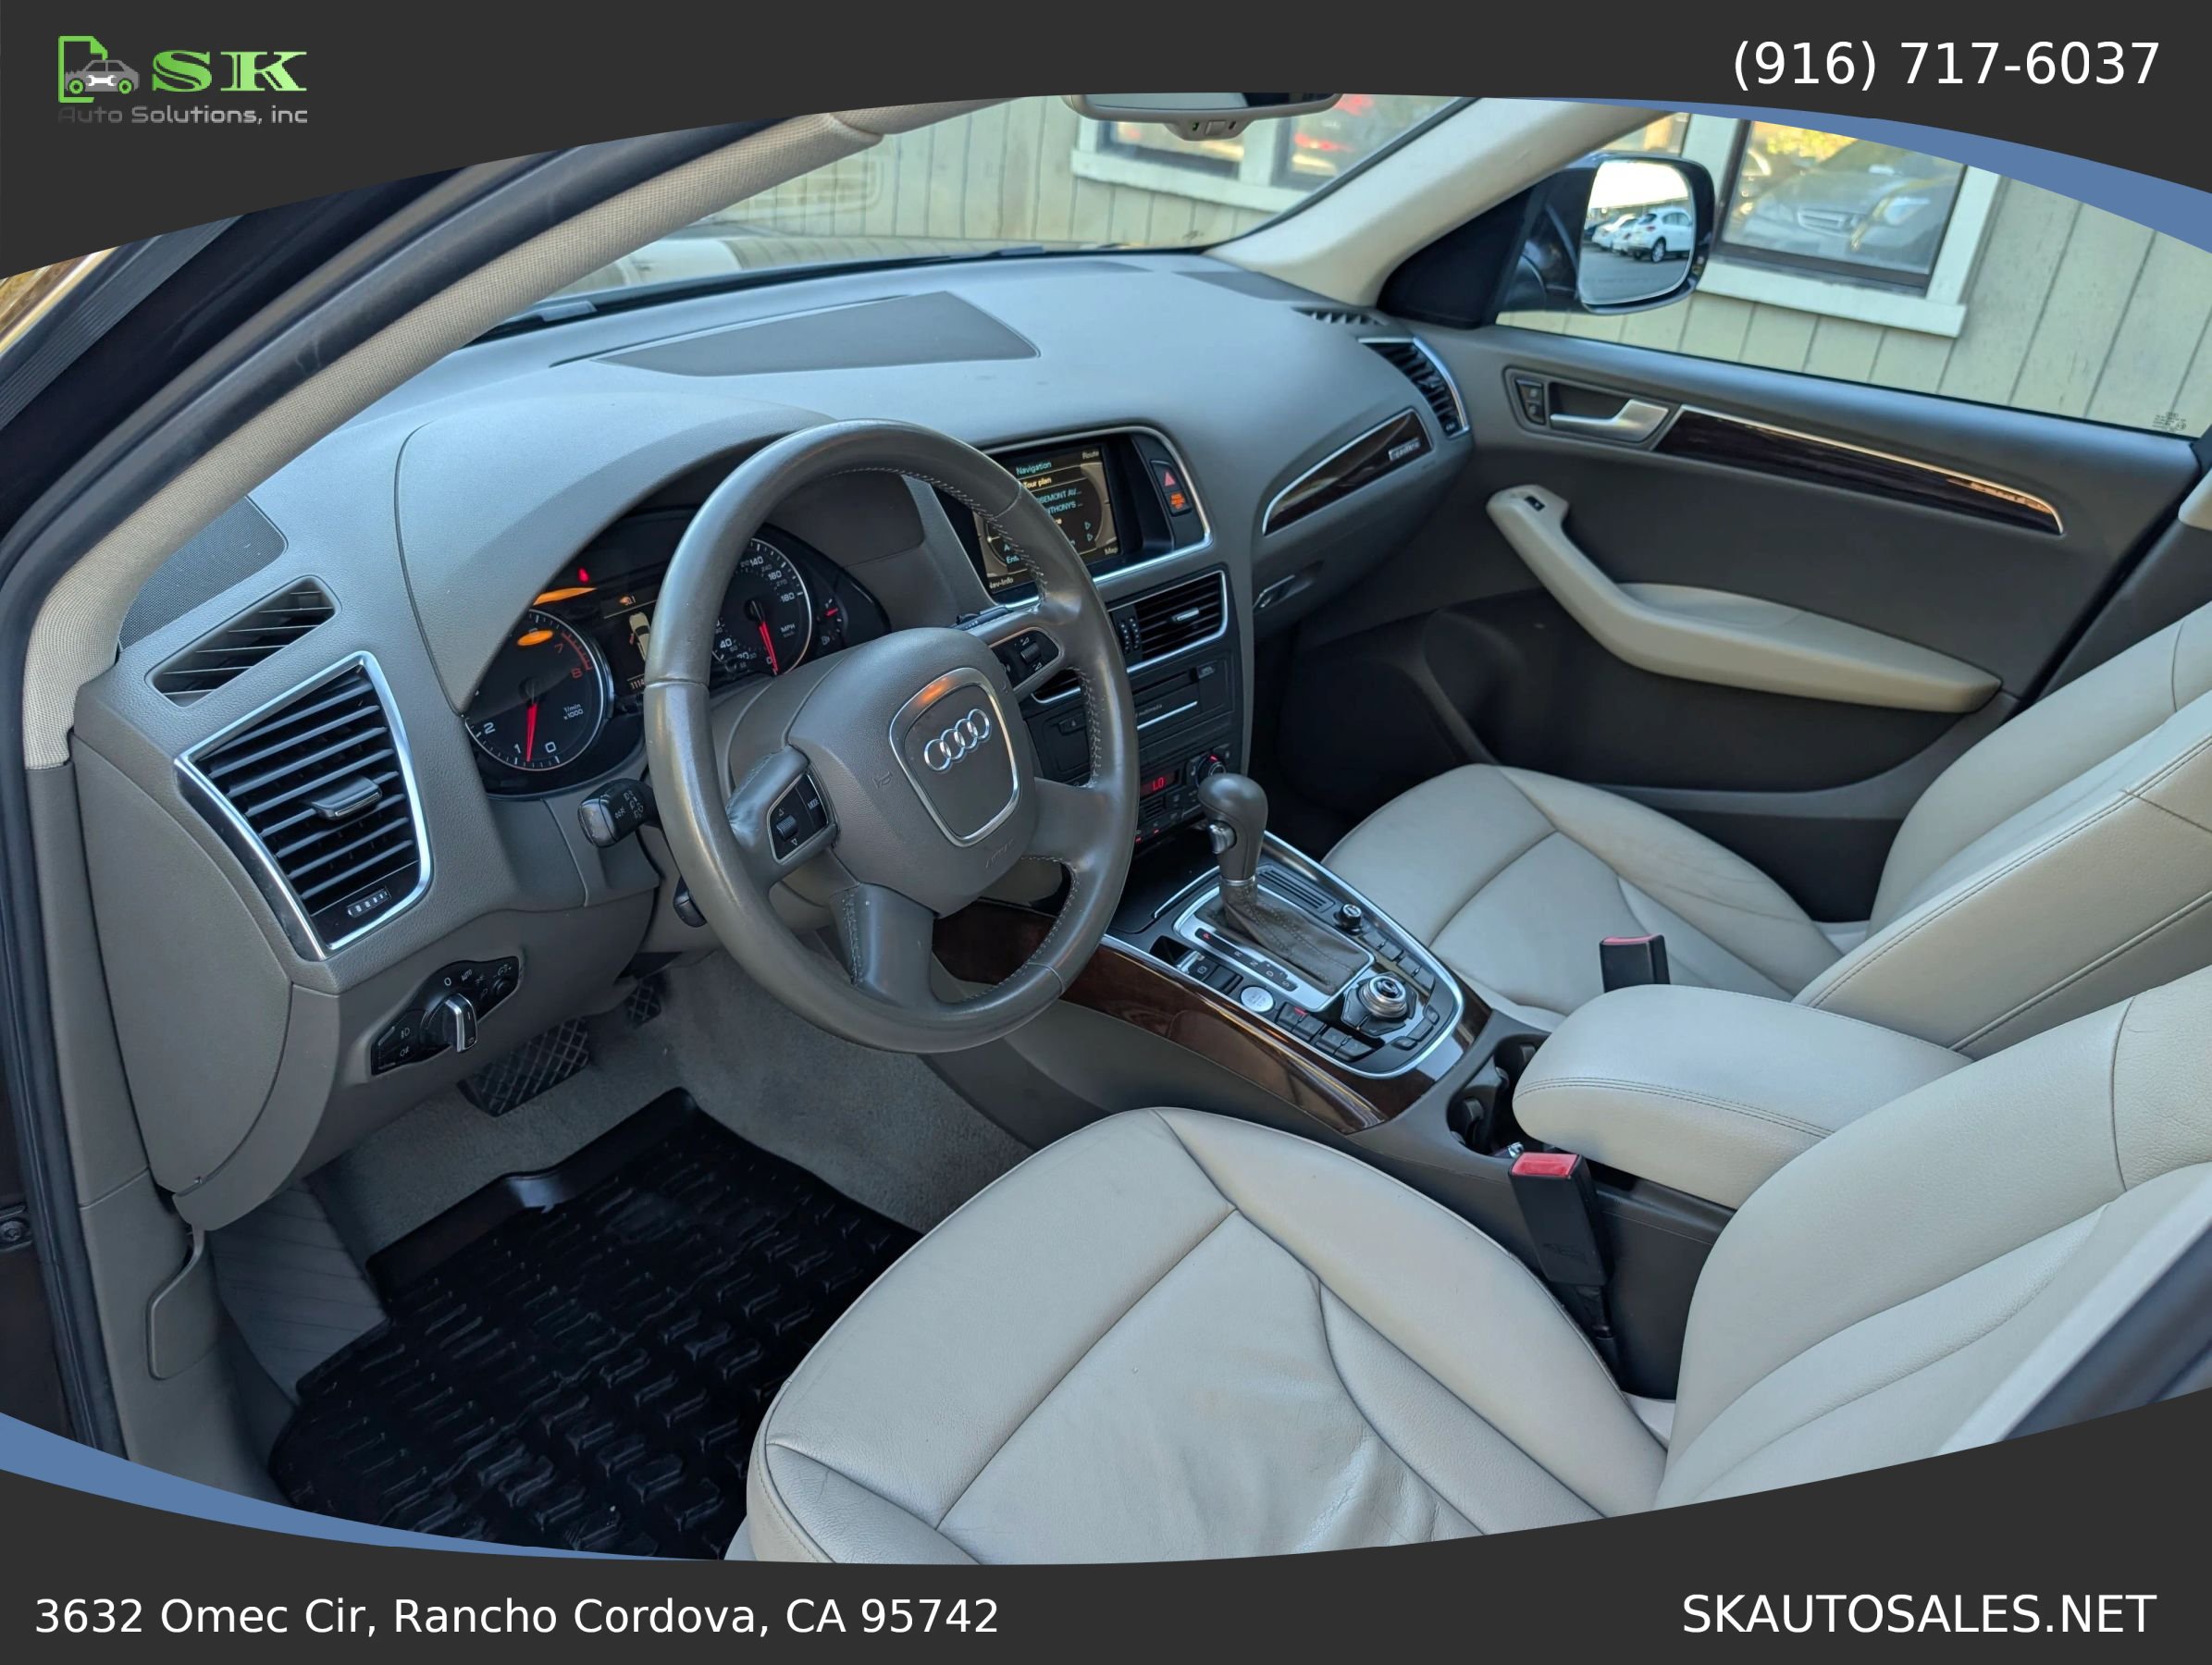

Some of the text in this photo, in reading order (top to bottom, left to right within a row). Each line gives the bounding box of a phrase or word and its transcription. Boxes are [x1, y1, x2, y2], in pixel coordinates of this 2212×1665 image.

[1016, 462, 1052, 475] Navigation
[1038, 477, 1052, 487] plan
[720, 638, 732, 648] 40
[484, 722, 495, 734] 2
